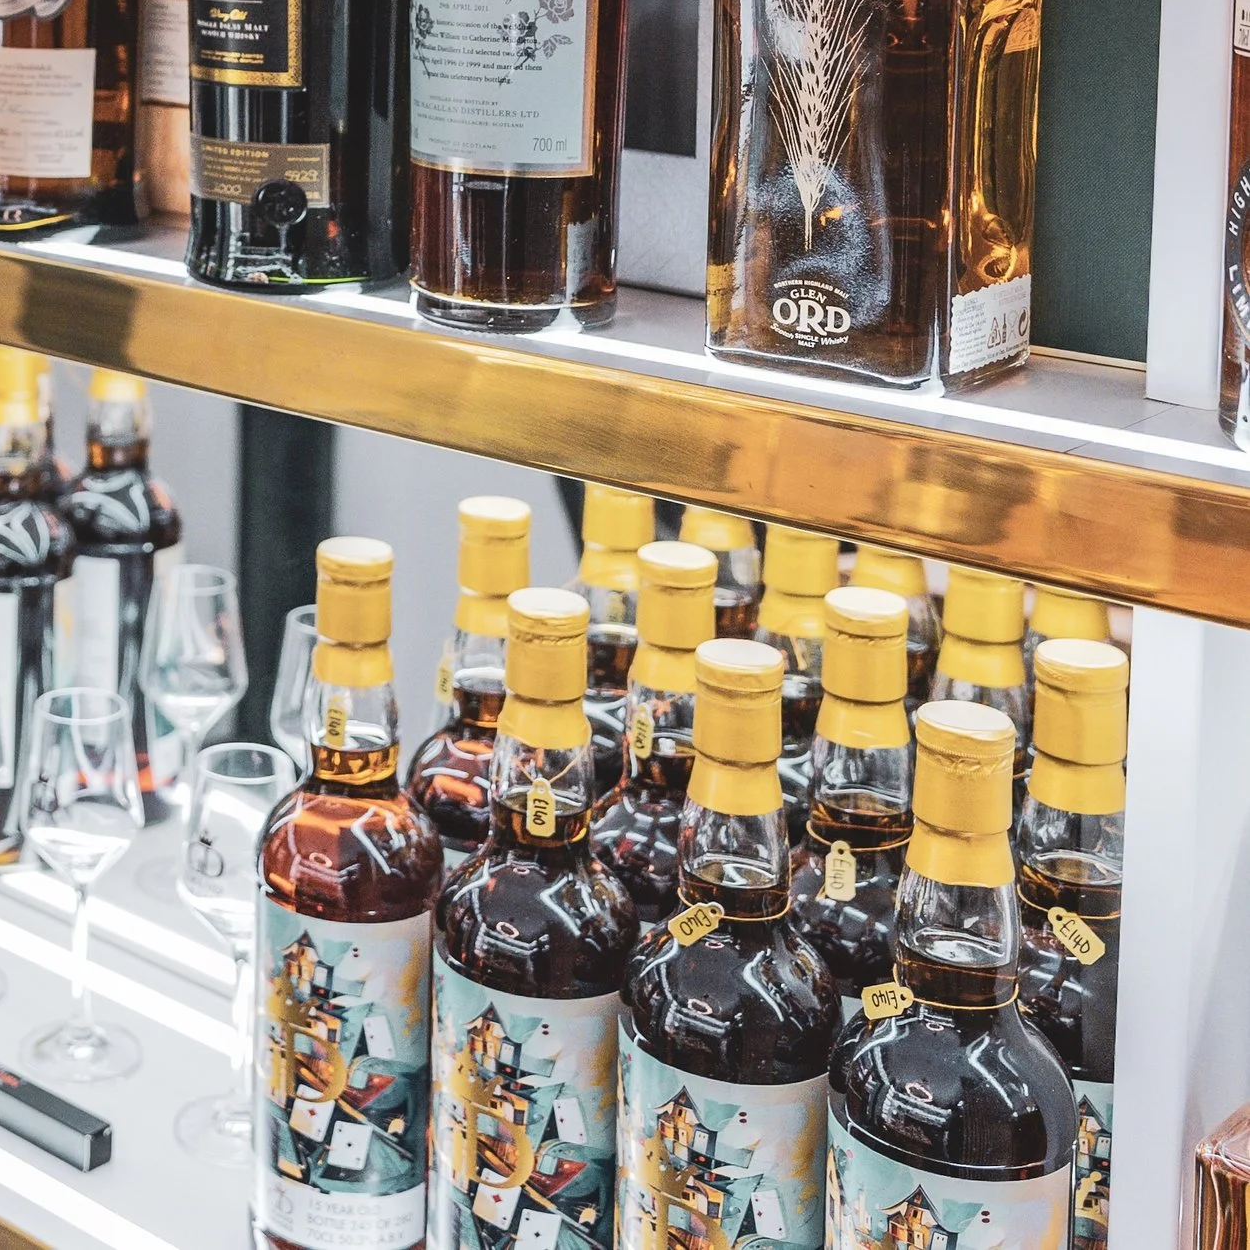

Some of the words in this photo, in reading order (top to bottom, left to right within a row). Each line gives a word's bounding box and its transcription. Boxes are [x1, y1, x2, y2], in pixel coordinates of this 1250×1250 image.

[452, 3, 472, 12] APRIL
[244, 23, 269, 32] MALT
[469, 35, 501, 43] Catherine
[475, 48, 501, 56] selected
[461, 106, 517, 118] DISTILLERS
[520, 110, 540, 118] LTD
[532, 138, 553, 152] 700
[555, 138, 568, 151] ml
[774, 279, 803, 289] NORTHERN
[804, 280, 834, 292] HIGHLAND
[834, 288, 850, 299] MALT
[790, 288, 827, 303] GLEN
[772, 298, 851, 336] ORD
[770, 323, 794, 340] Scotch
[794, 333, 819, 342] SINGLE
[820, 335, 849, 346] Whisky
[798, 340, 816, 348] MALT
[327, 1202, 353, 1216] YEAR
